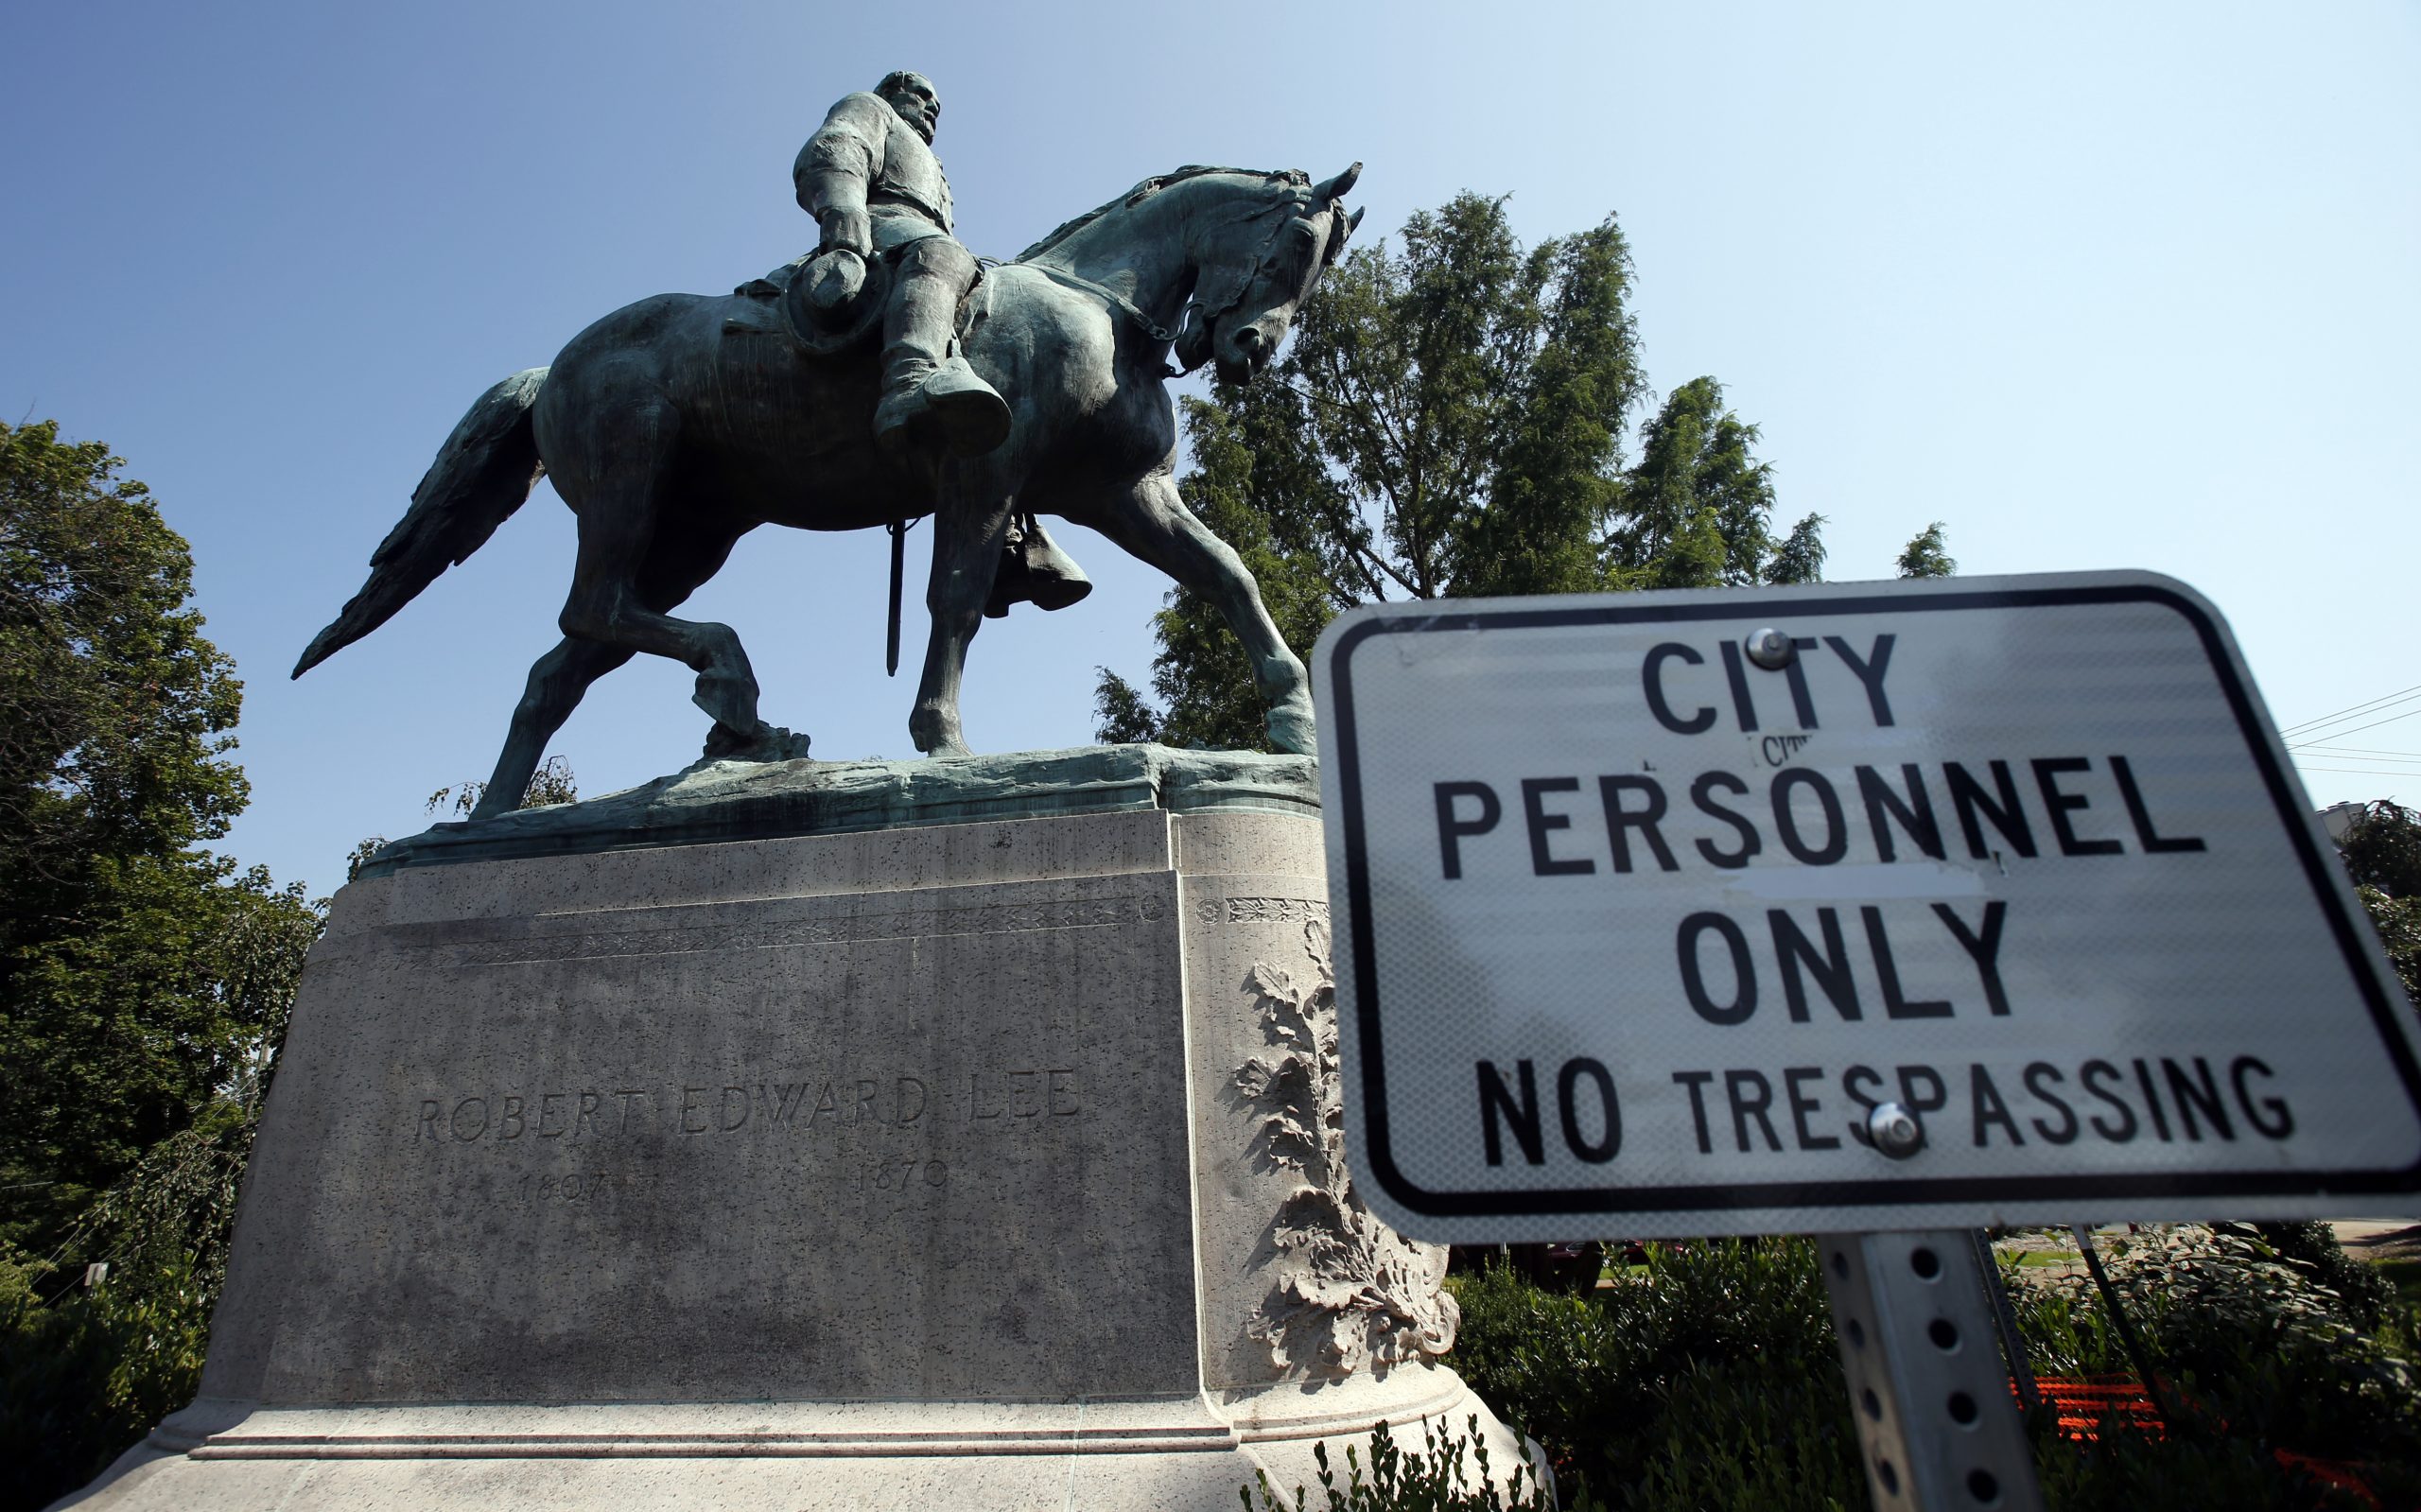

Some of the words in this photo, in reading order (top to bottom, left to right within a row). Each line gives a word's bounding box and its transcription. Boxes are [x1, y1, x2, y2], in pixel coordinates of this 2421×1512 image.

[1642, 634, 1897, 736] CITY
[1433, 754, 2211, 880] PERSONNEL
[1676, 899, 2012, 1027] ONLY
[413, 1088, 646, 1145] ROBERT
[676, 1077, 927, 1136] EDWARD
[967, 1068, 1081, 1121] LEE
[1473, 1055, 1623, 1170] NO
[1670, 1052, 2300, 1156] TRESPASSING
[520, 1173, 606, 1203] 1807
[855, 1159, 948, 1191] 1870
